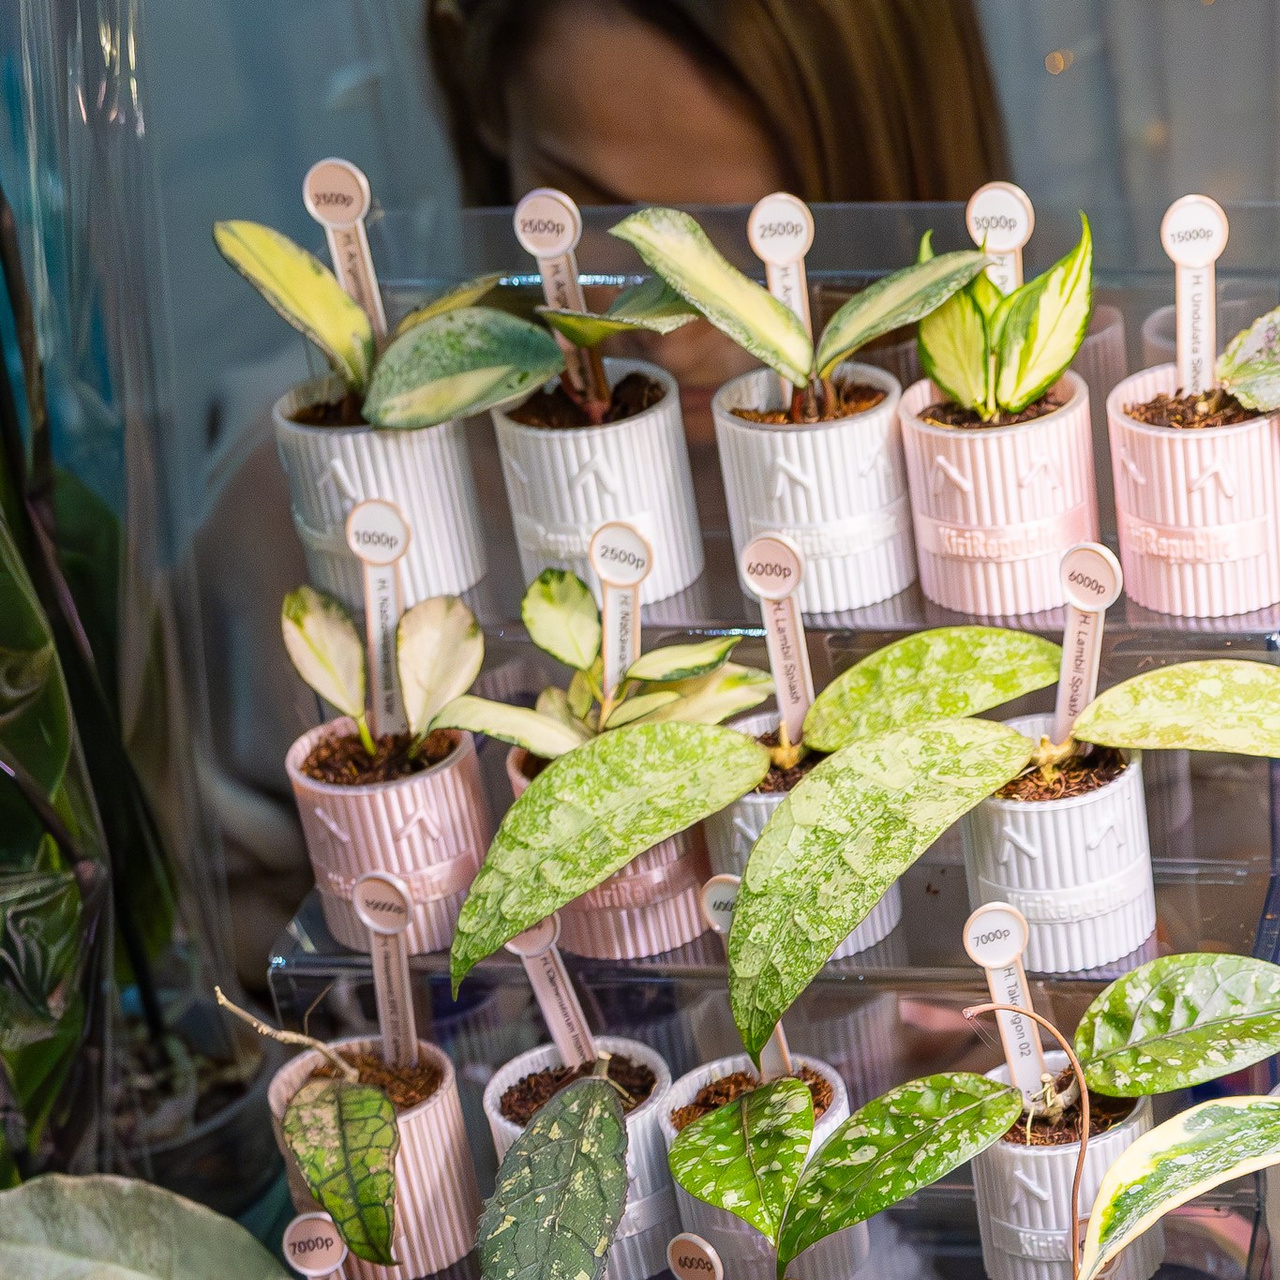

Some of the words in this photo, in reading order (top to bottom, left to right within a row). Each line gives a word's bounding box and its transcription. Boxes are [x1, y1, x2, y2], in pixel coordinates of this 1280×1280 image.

[759, 221, 804, 239] 2500p
[600, 545, 646, 569] 2500p
[747, 562, 792, 580] 6000p
[1067, 570, 1106, 595] 6000p
[973, 928, 1011, 948] 7000p
[1006, 980, 1027, 1040] Takegon
[1016, 1040, 1034, 1059] 02
[288, 1235, 334, 1255] 7000p
